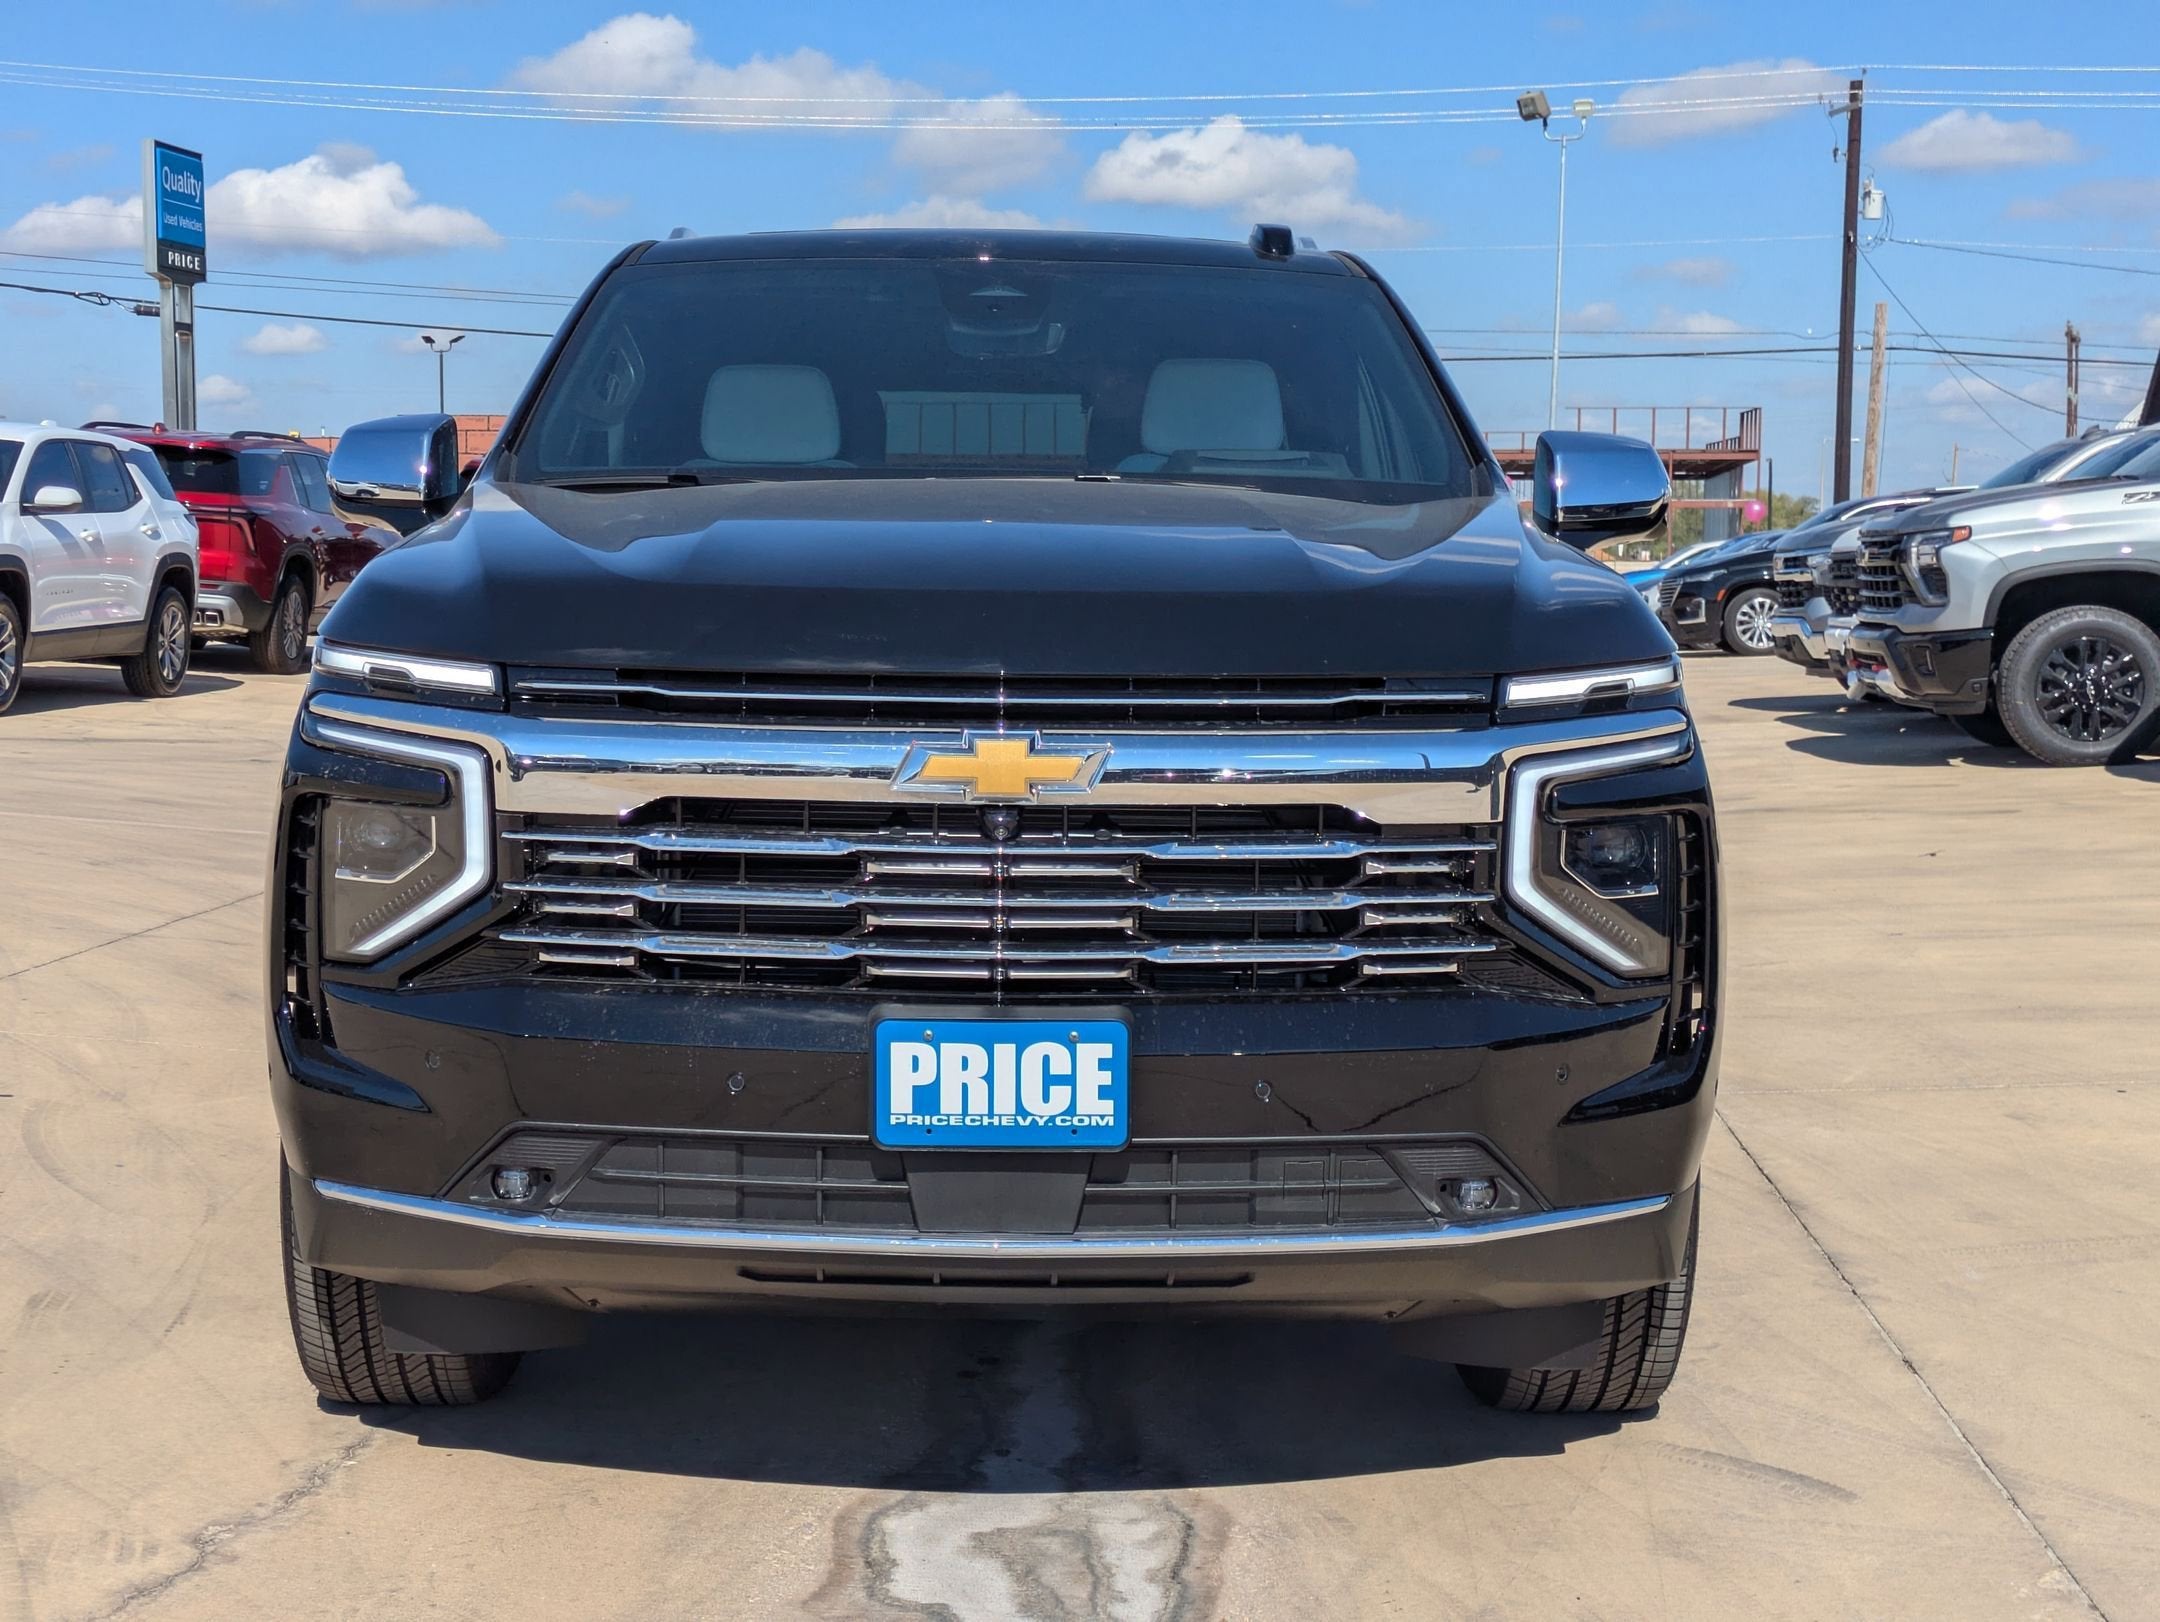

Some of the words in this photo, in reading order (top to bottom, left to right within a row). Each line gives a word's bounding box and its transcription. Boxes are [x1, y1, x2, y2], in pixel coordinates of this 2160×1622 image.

[162, 166, 202, 203] Quality
[163, 211, 178, 227] Used
[178, 215, 203, 232] Vehicles
[168, 251, 201, 270] PRICE
[890, 1041, 1114, 1116] PRICE
[890, 1114, 1114, 1126] PRICECHEVY.COM
